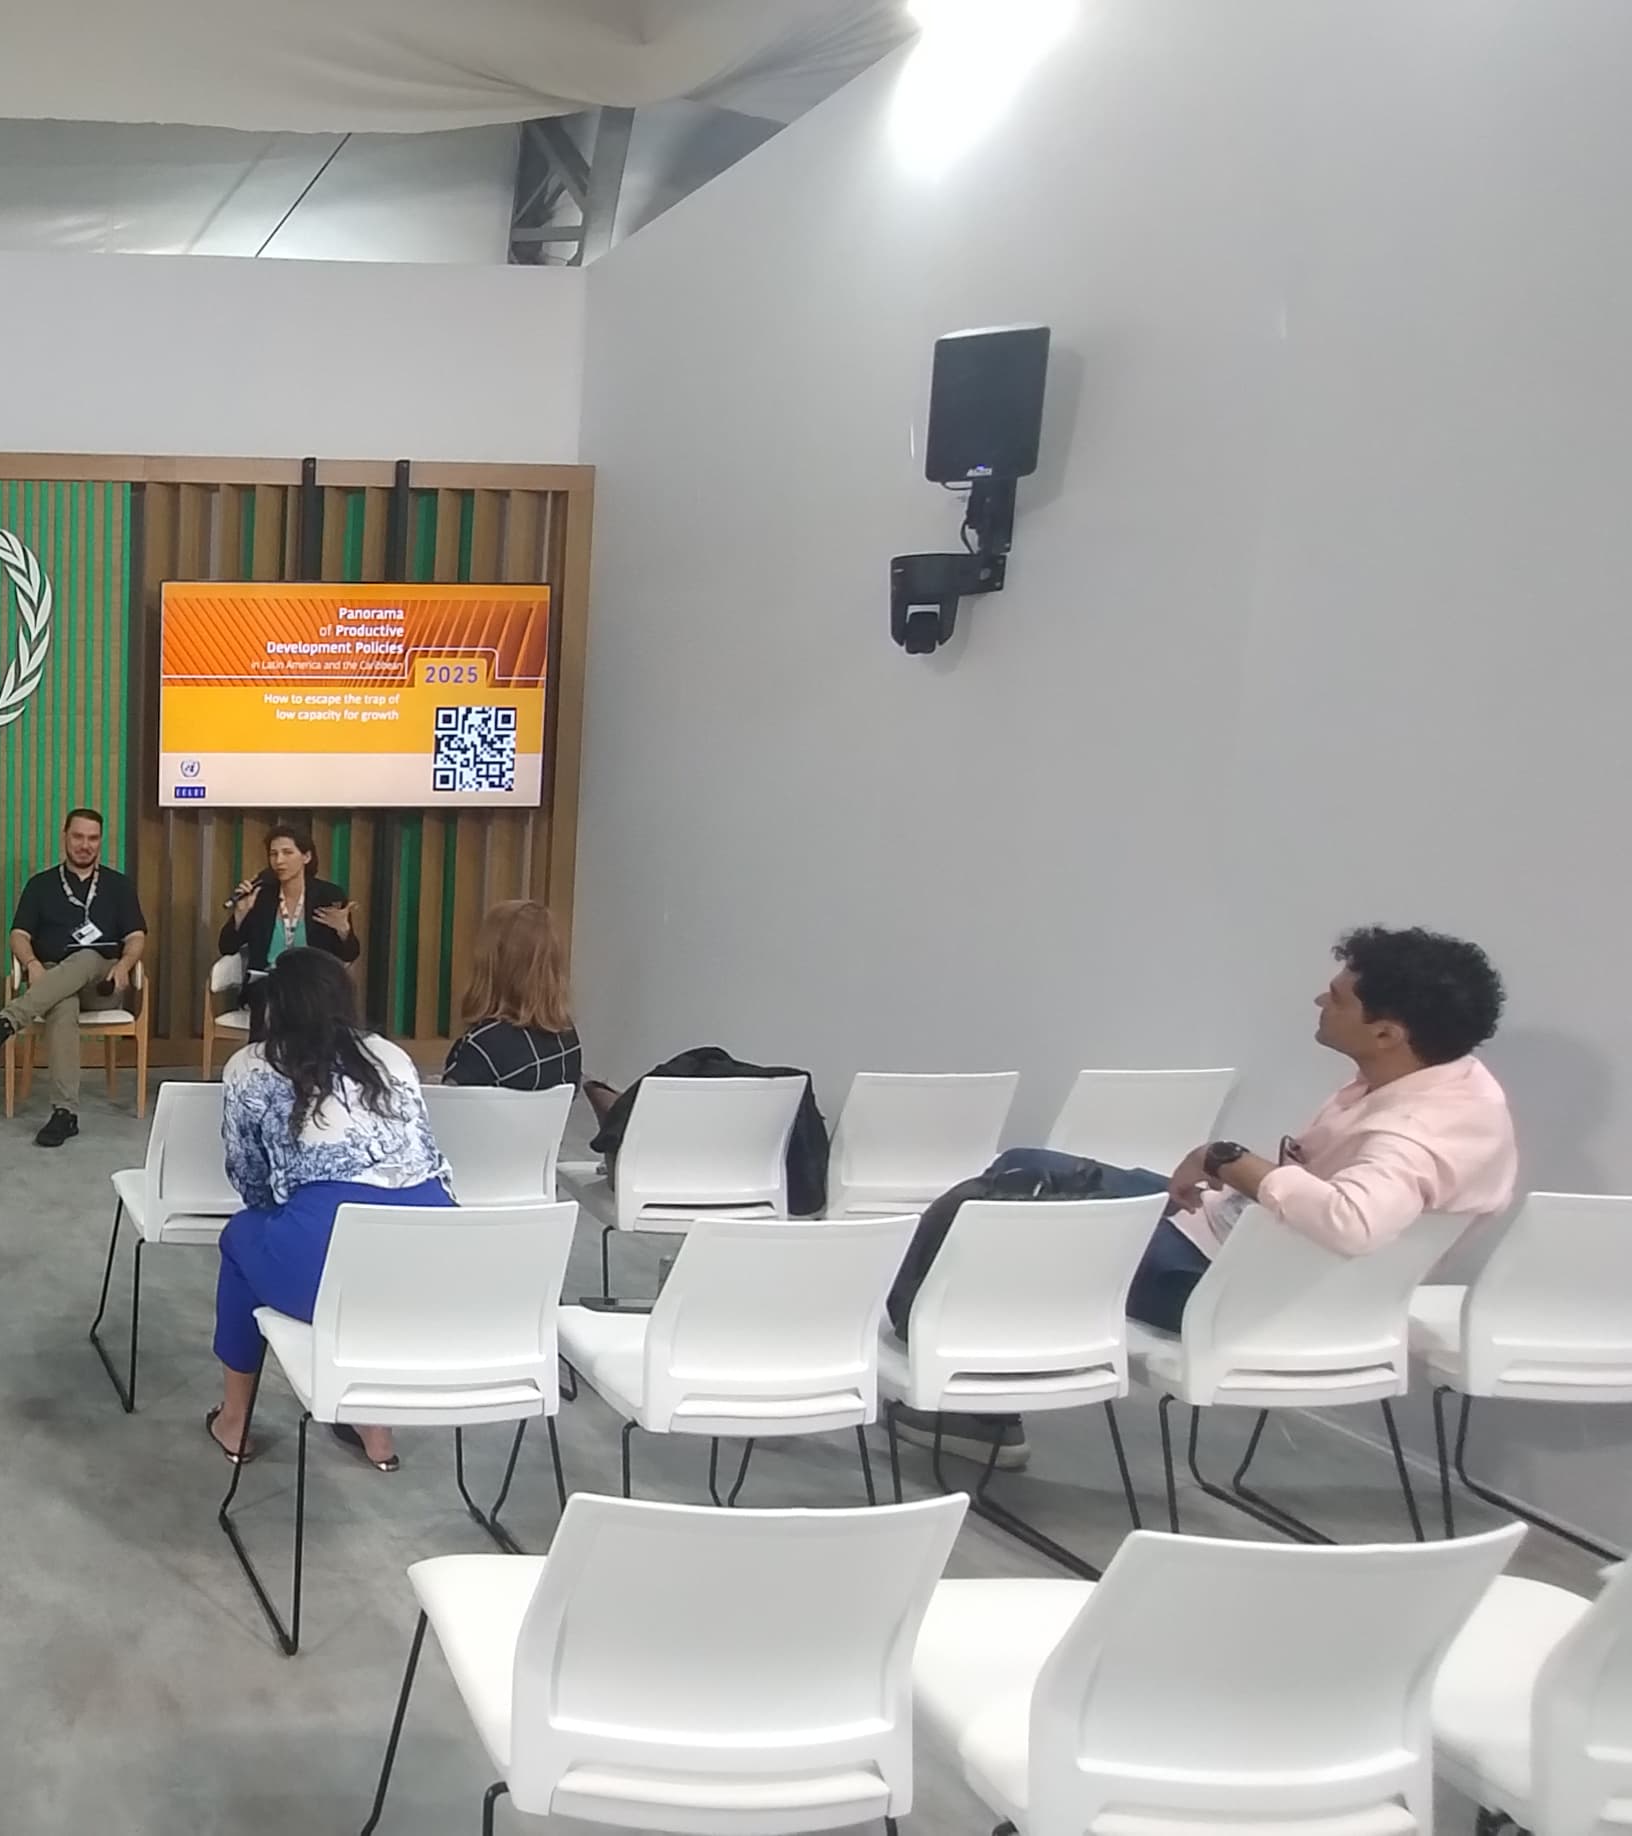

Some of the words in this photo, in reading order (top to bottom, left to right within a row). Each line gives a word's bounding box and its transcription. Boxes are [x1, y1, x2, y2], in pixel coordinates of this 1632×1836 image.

[338, 606, 404, 620] Panorama
[319, 623, 332, 637] of
[335, 624, 404, 638] Productive
[267, 641, 352, 656] Development
[355, 641, 404, 655] Policies
[323, 661, 341, 670] and
[425, 665, 478, 684] 2025
[263, 693, 289, 704] How
[290, 694, 303, 705] to
[304, 695, 342, 707] escape
[343, 693, 362, 705] the
[364, 695, 386, 707] trap
[388, 692, 400, 705] of
[275, 708, 296, 720] low
[297, 710, 342, 722] capacity
[343, 709, 359, 720] for
[361, 709, 399, 722] growth
